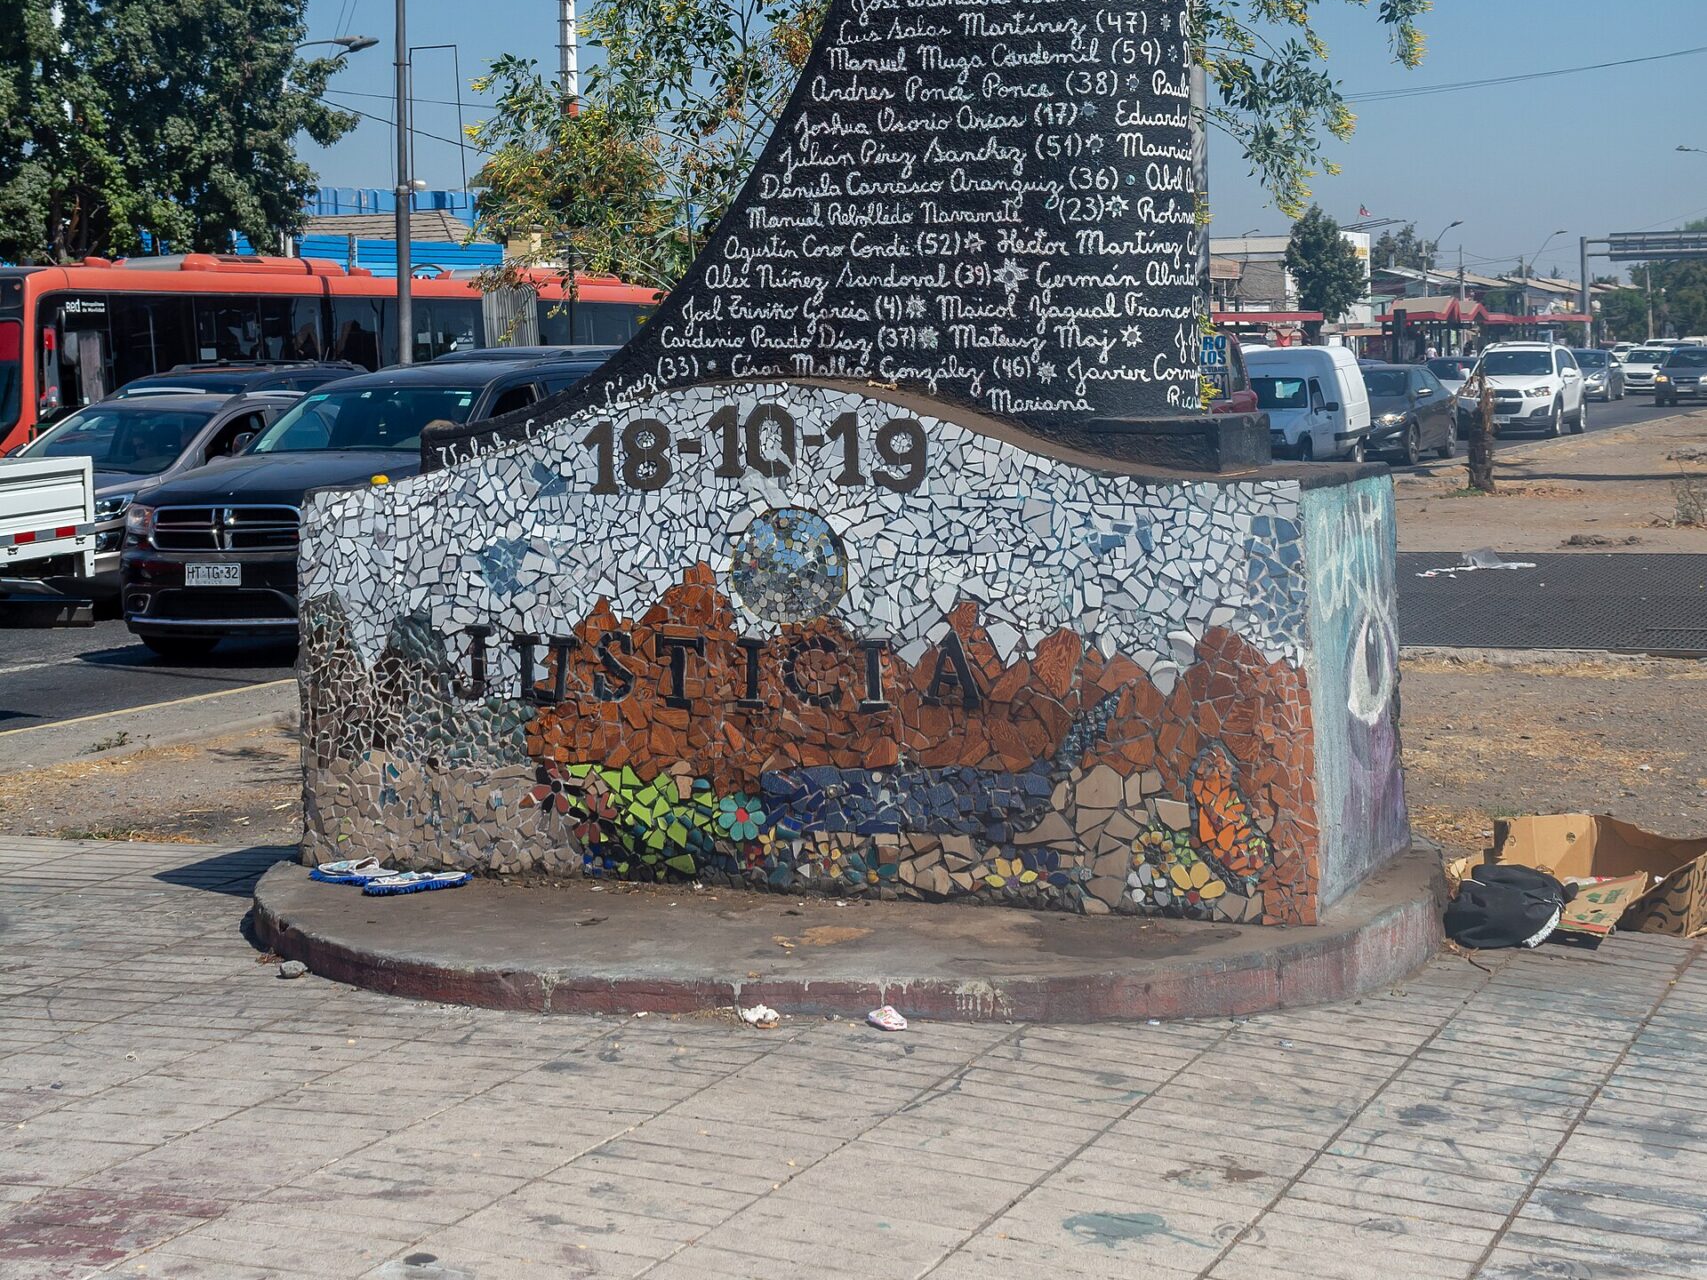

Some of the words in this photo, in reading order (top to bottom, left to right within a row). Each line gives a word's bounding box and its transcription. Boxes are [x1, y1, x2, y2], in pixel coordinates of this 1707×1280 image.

[836, 19, 882, 46] Luis
[958, 12, 1086, 51] Martínez
[1096, 9, 1147, 36] (47)
[826, 45, 908, 73] Manuel
[917, 43, 987, 85] Muga
[1111, 37, 1160, 66] (59)
[811, 74, 895, 102] Andres
[1066, 70, 1118, 97] (38)
[794, 110, 872, 152] Joshua
[957, 104, 1027, 131] Arias
[1034, 102, 1078, 126] (17)
[1115, 99, 1189, 127] Eduardo
[779, 140, 855, 185] Julián
[861, 138, 917, 180] Pérez
[1035, 132, 1082, 160] (51)
[1116, 132, 1192, 161] Maurici
[760, 172, 843, 199] Daniela
[846, 170, 945, 196] Carrasco
[1068, 165, 1119, 191] (36)
[746, 202, 824, 229] Manuel
[1059, 193, 1104, 225] (23)
[724, 233, 799, 275] Agustín
[916, 230, 960, 257] (52)
[1075, 229, 1183, 270] Martínez
[705, 263, 751, 289] Alex
[756, 263, 829, 306] Núñez
[836, 260, 951, 288] Sandoval
[954, 261, 991, 289] (39)
[1036, 261, 1141, 289] Germán
[682, 294, 724, 337] Joel
[875, 294, 902, 321] (4)
[936, 294, 1017, 321] Maicol
[1125, 291, 1191, 320] Franco
[750, 324, 814, 349] Prado
[817, 323, 873, 365] Díaz
[877, 324, 916, 352] (37)
[948, 324, 1047, 364] Mateusz
[1053, 324, 1117, 364] Maj
[657, 355, 699, 385] (33)
[731, 353, 784, 377] César
[993, 355, 1031, 379] (46)
[1067, 356, 1152, 396] Javier
[986, 387, 1095, 413] Mariana
[581, 403, 927, 495] 18-10-19
[452, 623, 982, 714] JUSTICIA
